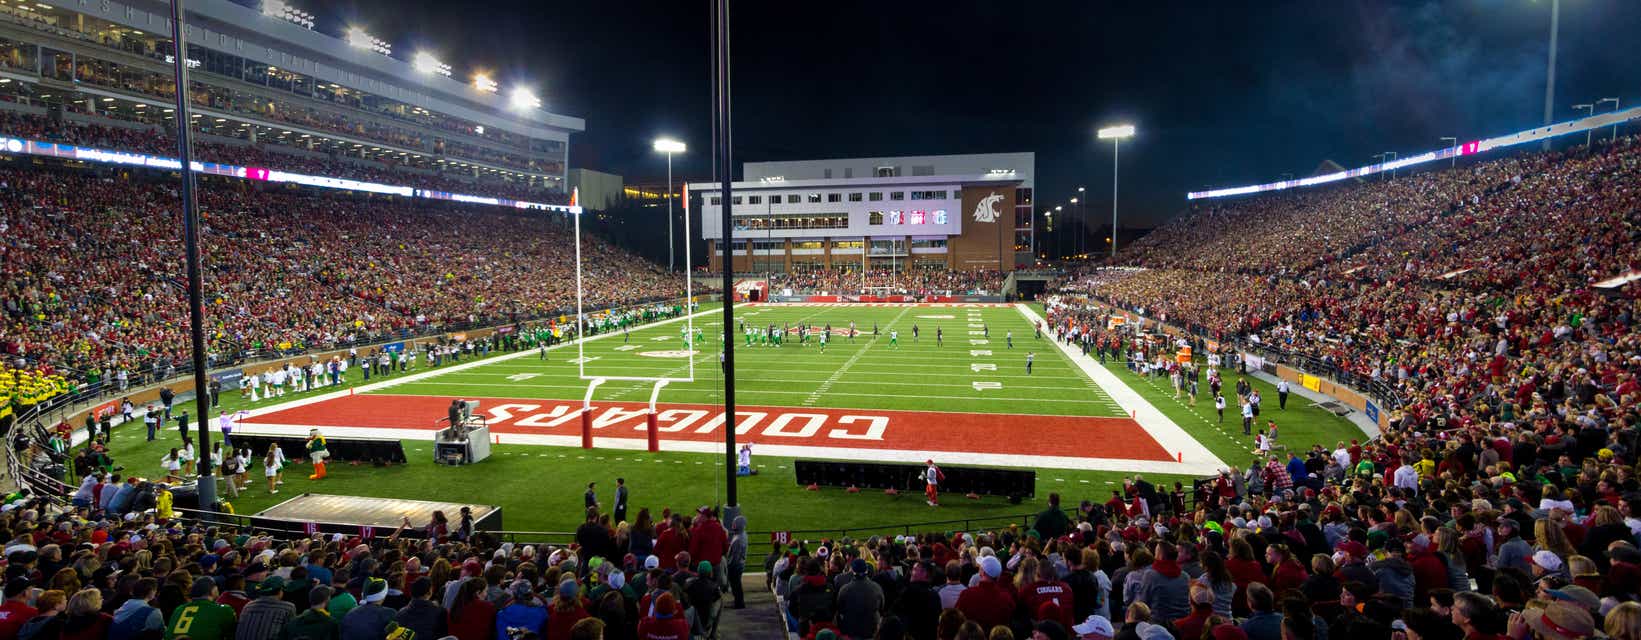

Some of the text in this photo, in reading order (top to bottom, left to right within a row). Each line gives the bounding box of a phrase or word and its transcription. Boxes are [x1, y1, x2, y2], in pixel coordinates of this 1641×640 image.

[485, 402, 890, 441] COUGARS
[776, 531, 787, 544] 18
[1036, 585, 1064, 595] COUGARS
[173, 606, 200, 634] 6
